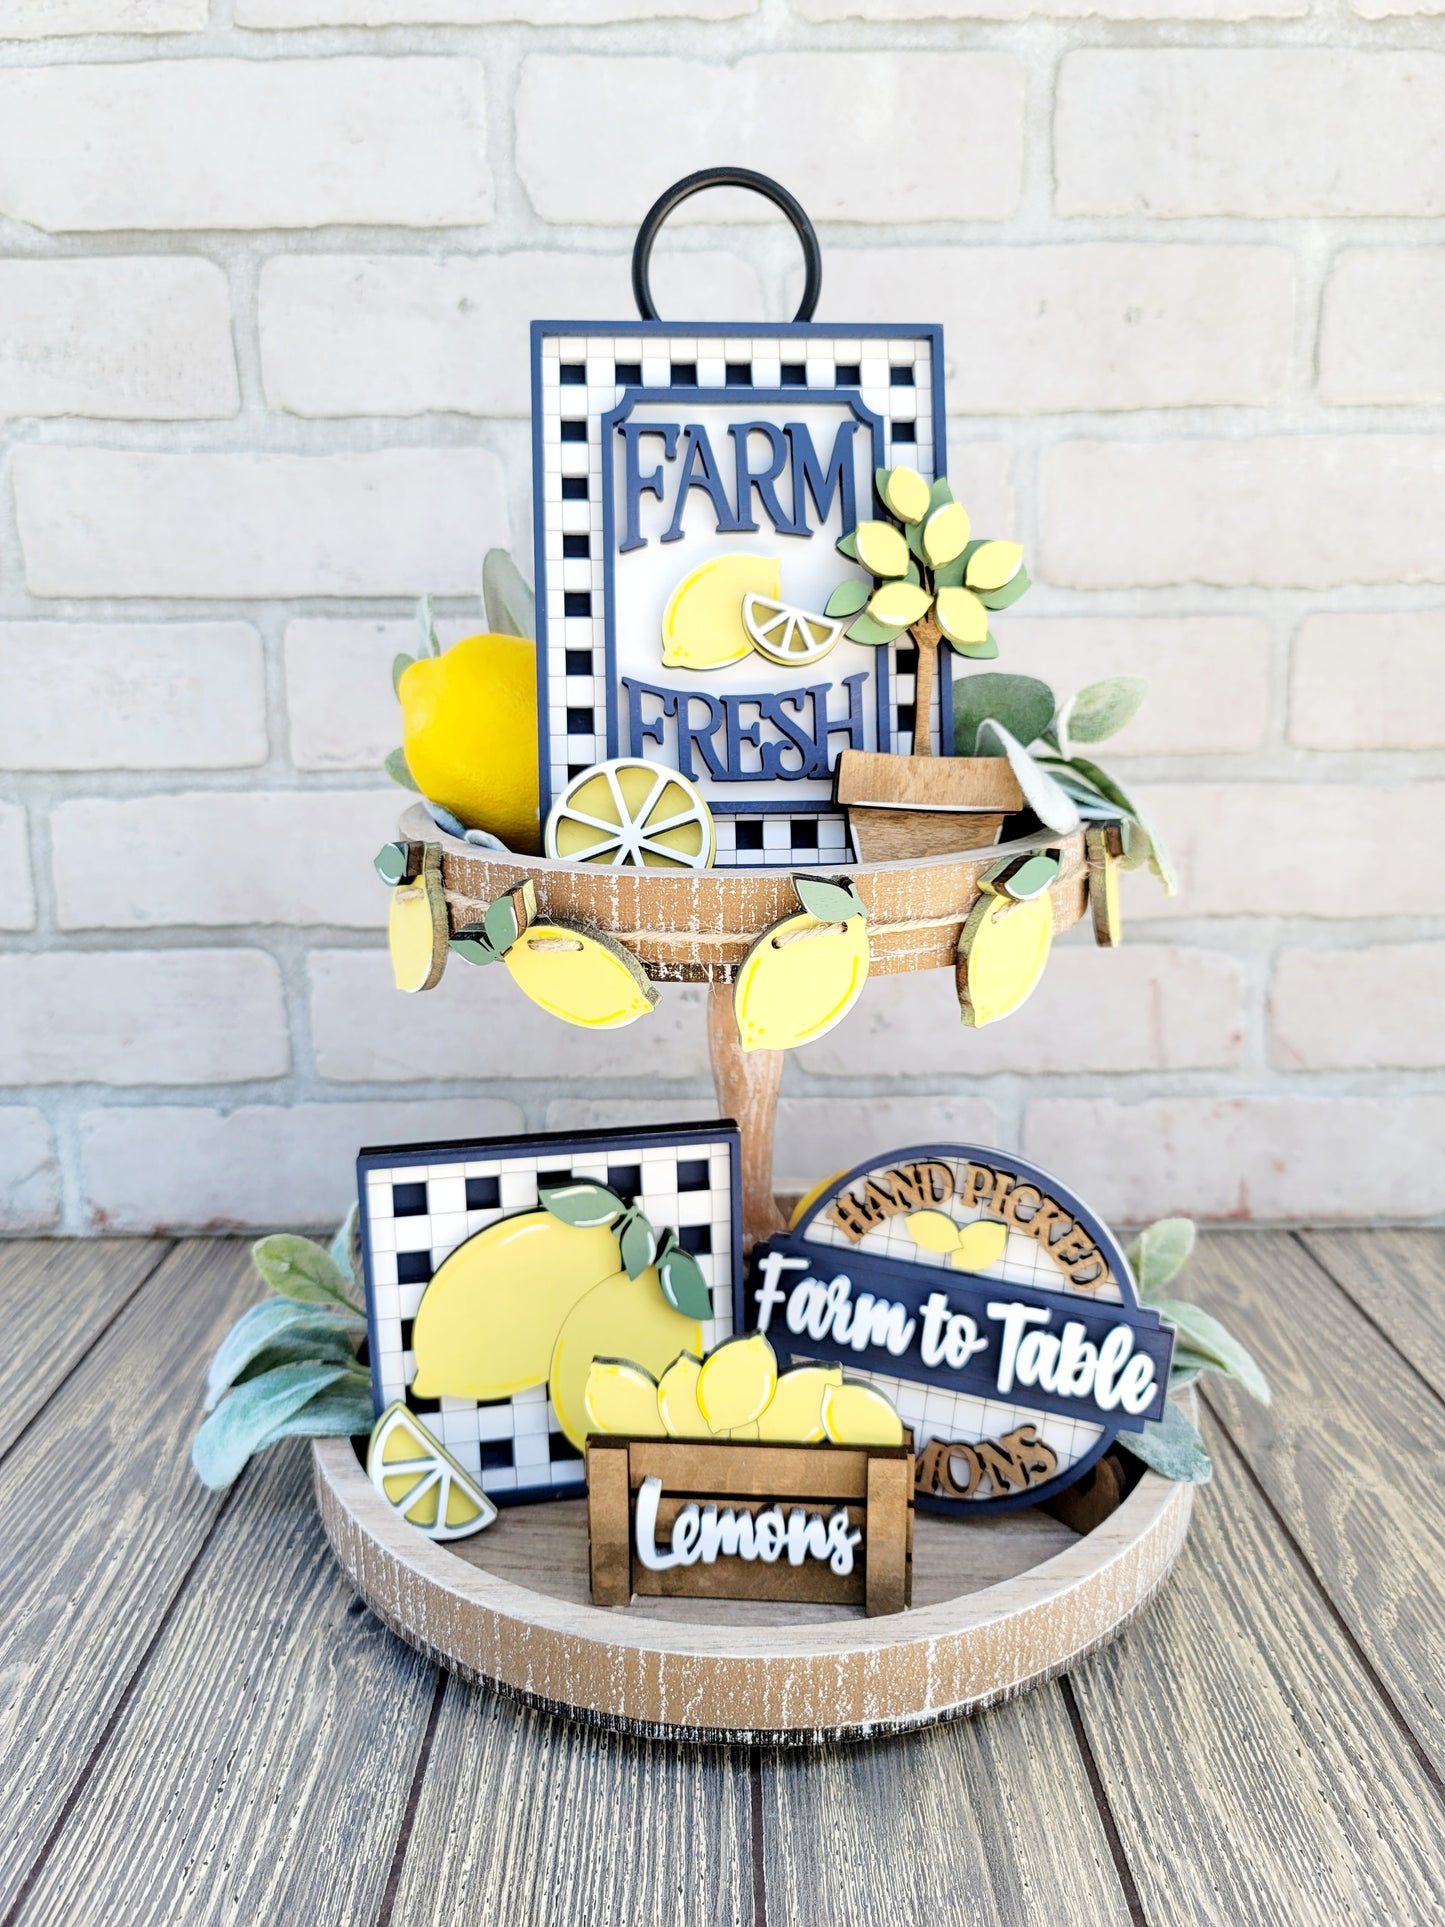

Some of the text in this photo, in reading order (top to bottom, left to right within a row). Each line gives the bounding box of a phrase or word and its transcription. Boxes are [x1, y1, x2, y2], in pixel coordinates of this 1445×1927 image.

[617, 421, 859, 552] FARM
[621, 672, 870, 782] FRESH
[826, 1161, 1110, 1291] HAND PICKED
[755, 1251, 1158, 1415] Farm to Table
[635, 1475, 862, 1576] Lemons
